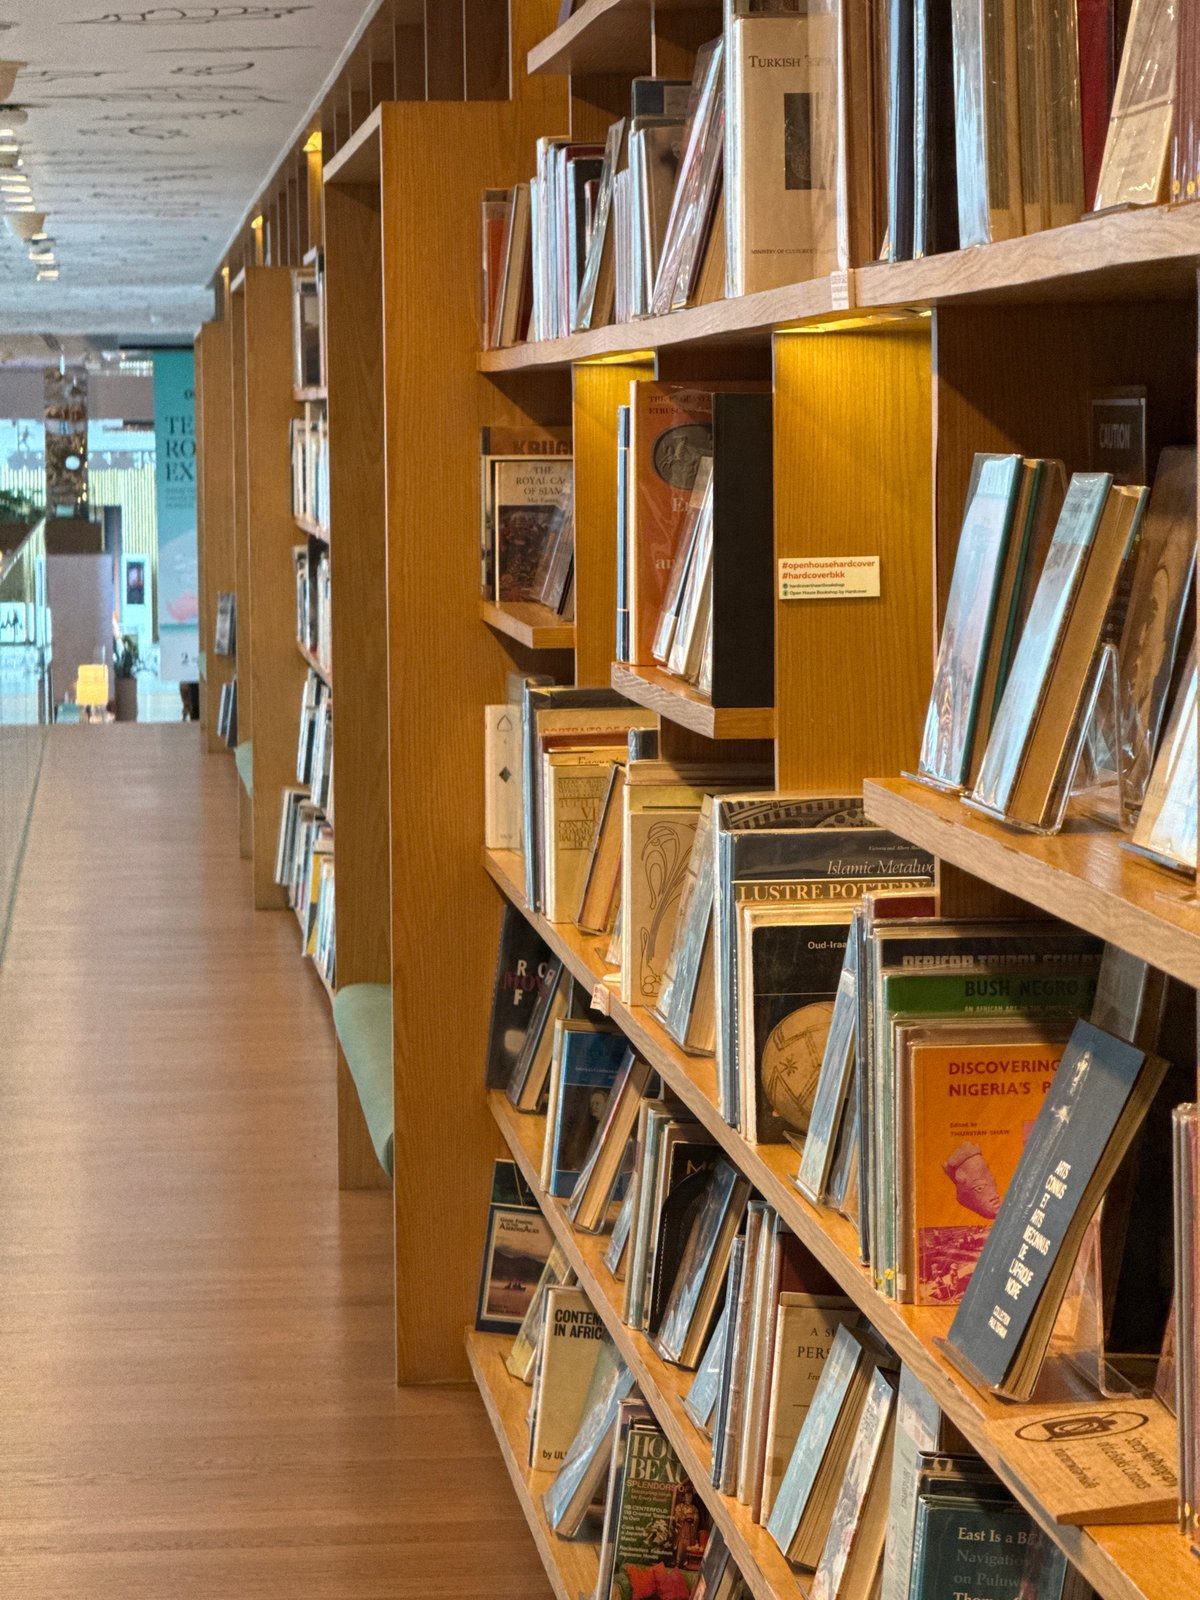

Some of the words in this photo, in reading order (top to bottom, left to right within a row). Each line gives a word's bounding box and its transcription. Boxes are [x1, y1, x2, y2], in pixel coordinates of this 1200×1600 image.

[748, 55, 800, 68] TURKISH
[534, 466, 553, 475] THE
[516, 476, 548, 485] ROYAL
[523, 486, 536, 495] OF
[782, 560, 875, 570] #openhousehardcover
[782, 571, 845, 579] #hardcoverbkk
[827, 860, 874, 876] Islamic
[877, 858, 935, 875] Metalwo
[739, 884, 824, 902] LUSTRE
[964, 979, 1010, 998] BUSH
[1019, 978, 1080, 997] NEGRO
[948, 1059, 1061, 1075] DISCOVERING
[948, 1081, 1031, 1097] NIGERIA'S
[1054, 1160, 1072, 1180] ARTS
[554, 1323, 566, 1337] IN
[569, 1325, 602, 1340] AFRIC
[810, 1327, 818, 1337] A
[542, 1449, 552, 1460] by
[629, 1457, 688, 1484] BEAU
[626, 1480, 678, 1492] SPLENDORS
[957, 1527, 986, 1541] East
[989, 1529, 1001, 1543] Is
[1005, 1534, 1013, 1544] a
[953, 1574, 972, 1584] on
[976, 1572, 1020, 1587] Puluw
